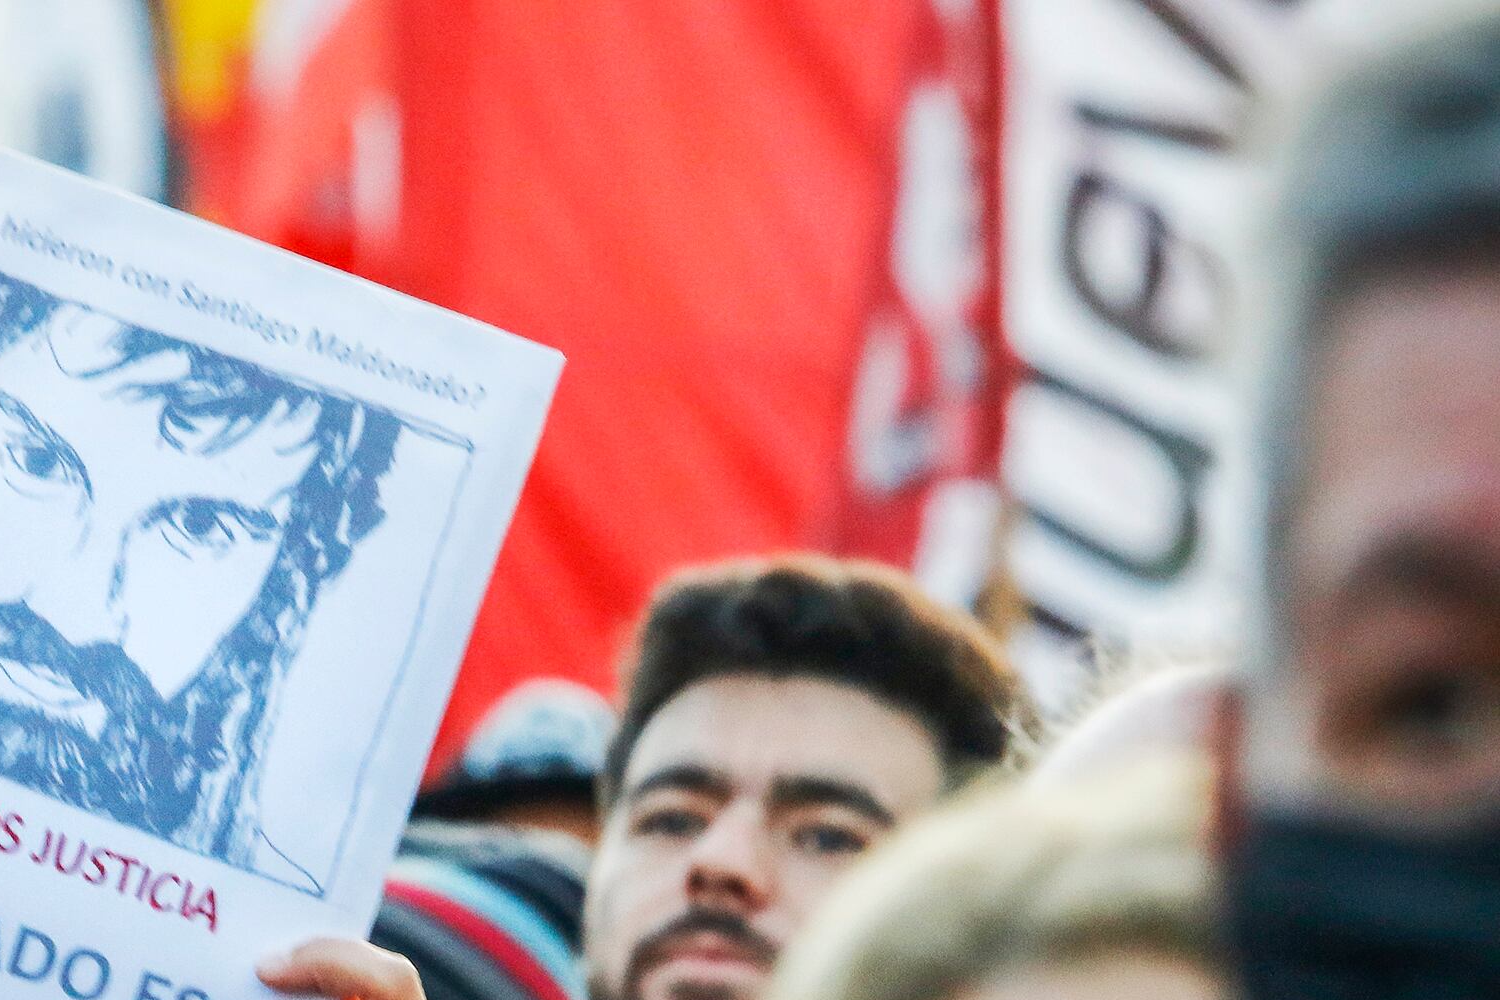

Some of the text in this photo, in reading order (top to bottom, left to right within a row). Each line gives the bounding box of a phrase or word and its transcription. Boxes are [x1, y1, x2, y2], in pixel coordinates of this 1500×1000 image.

[0, 214, 115, 276] hicieron
[120, 262, 171, 304] con
[175, 279, 299, 344] Santiago
[305, 326, 487, 408] Maldonado?
[29, 827, 220, 933] JUSTICIA
